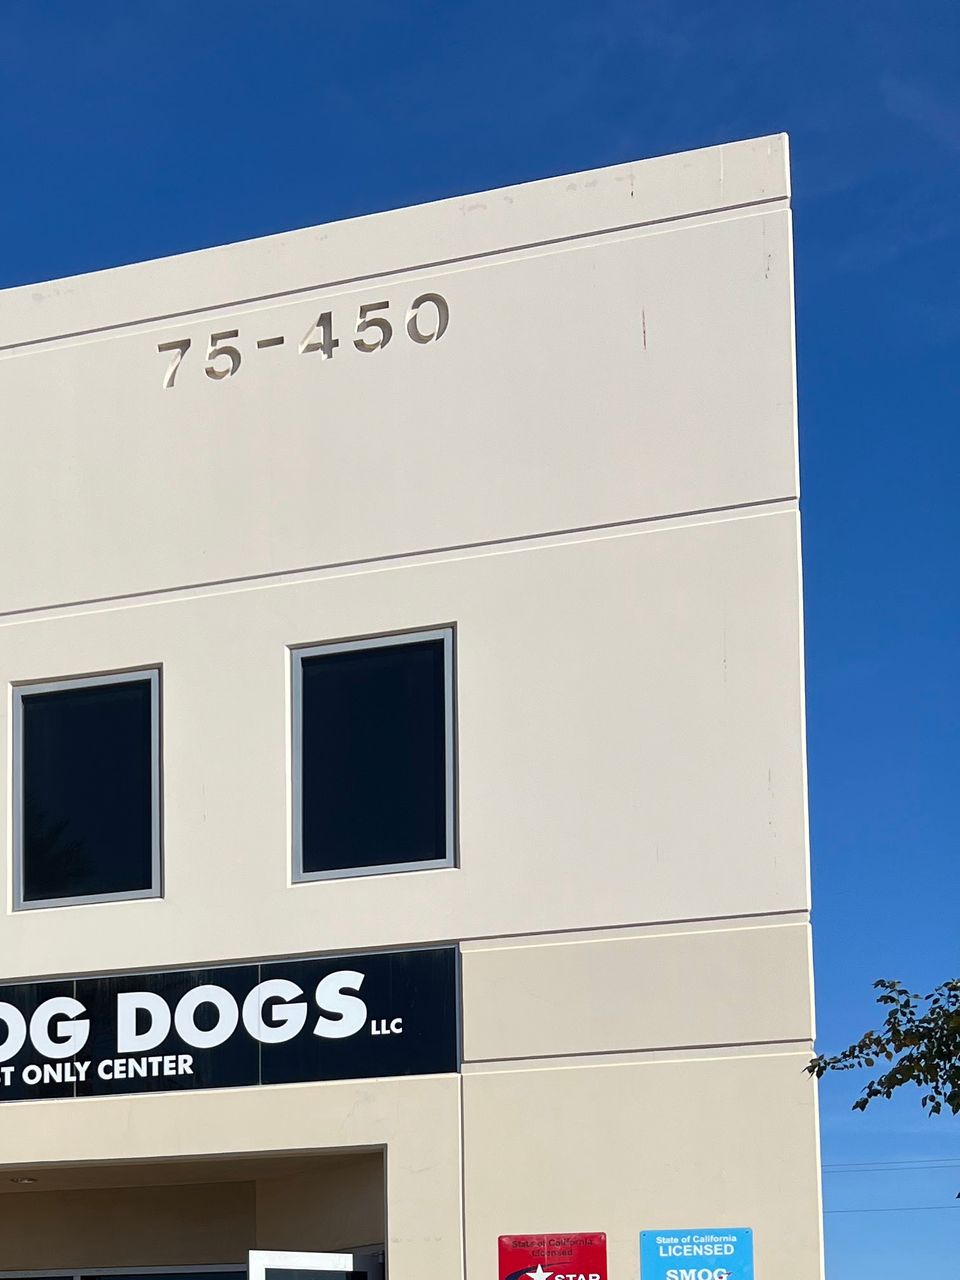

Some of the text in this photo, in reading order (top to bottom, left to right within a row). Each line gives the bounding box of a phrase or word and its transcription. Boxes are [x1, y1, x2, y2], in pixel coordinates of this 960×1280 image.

[157, 292, 450, 390] 75-450
[116, 970, 368, 1055] DOGS
[370, 1017, 403, 1036] LLC
[21, 1060, 91, 1086] ONLY
[97, 1054, 194, 1081] CENTER
[655, 1234, 737, 1244] State of California
[659, 1244, 734, 1257] LICENSED
